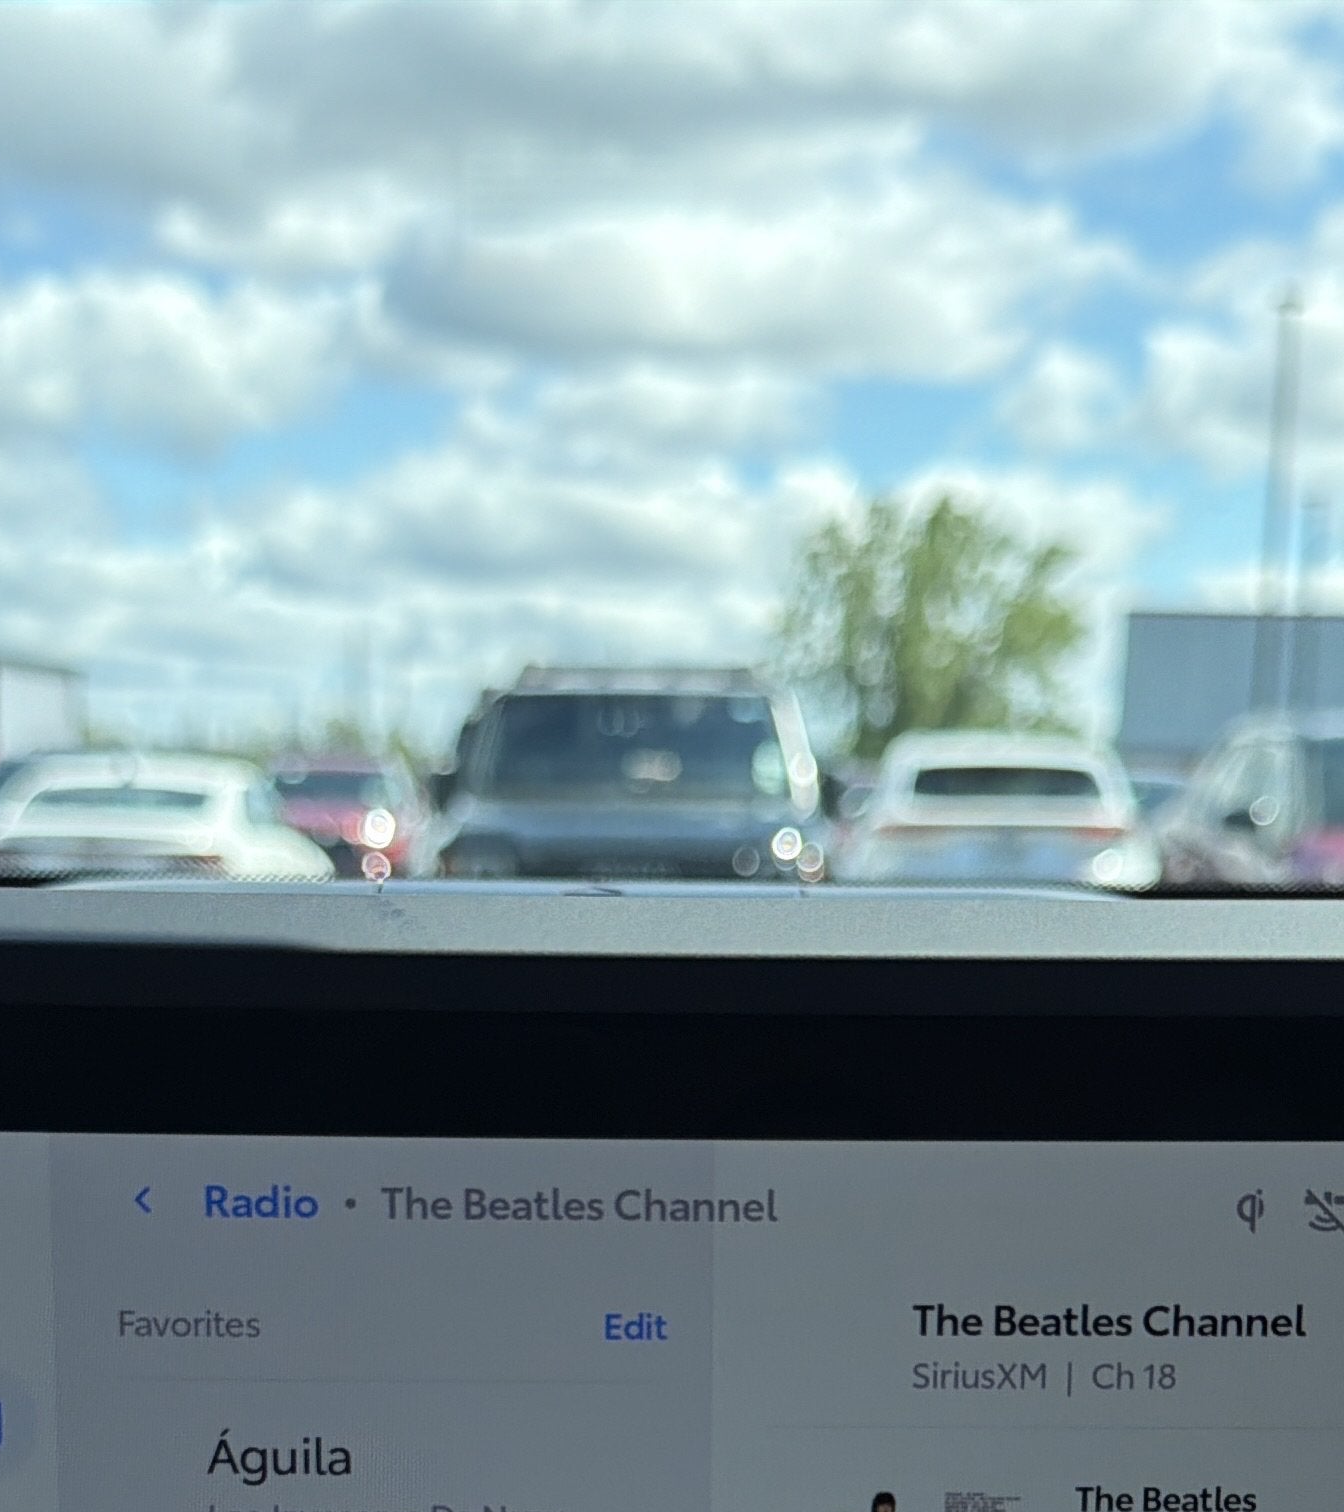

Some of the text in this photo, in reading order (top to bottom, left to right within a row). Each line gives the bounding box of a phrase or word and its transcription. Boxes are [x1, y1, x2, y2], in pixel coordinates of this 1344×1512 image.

[205, 1184, 778, 1222] Radio The Beatles Channel
[119, 1309, 261, 1338] Favorites
[605, 1312, 668, 1341] Edit
[912, 1303, 1307, 1337] The Beatles Channel
[912, 1361, 1176, 1390] SiriusXM Ch 18
[207, 1428, 353, 1487] Águila
[1075, 1485, 1257, 1512] The Beatles
